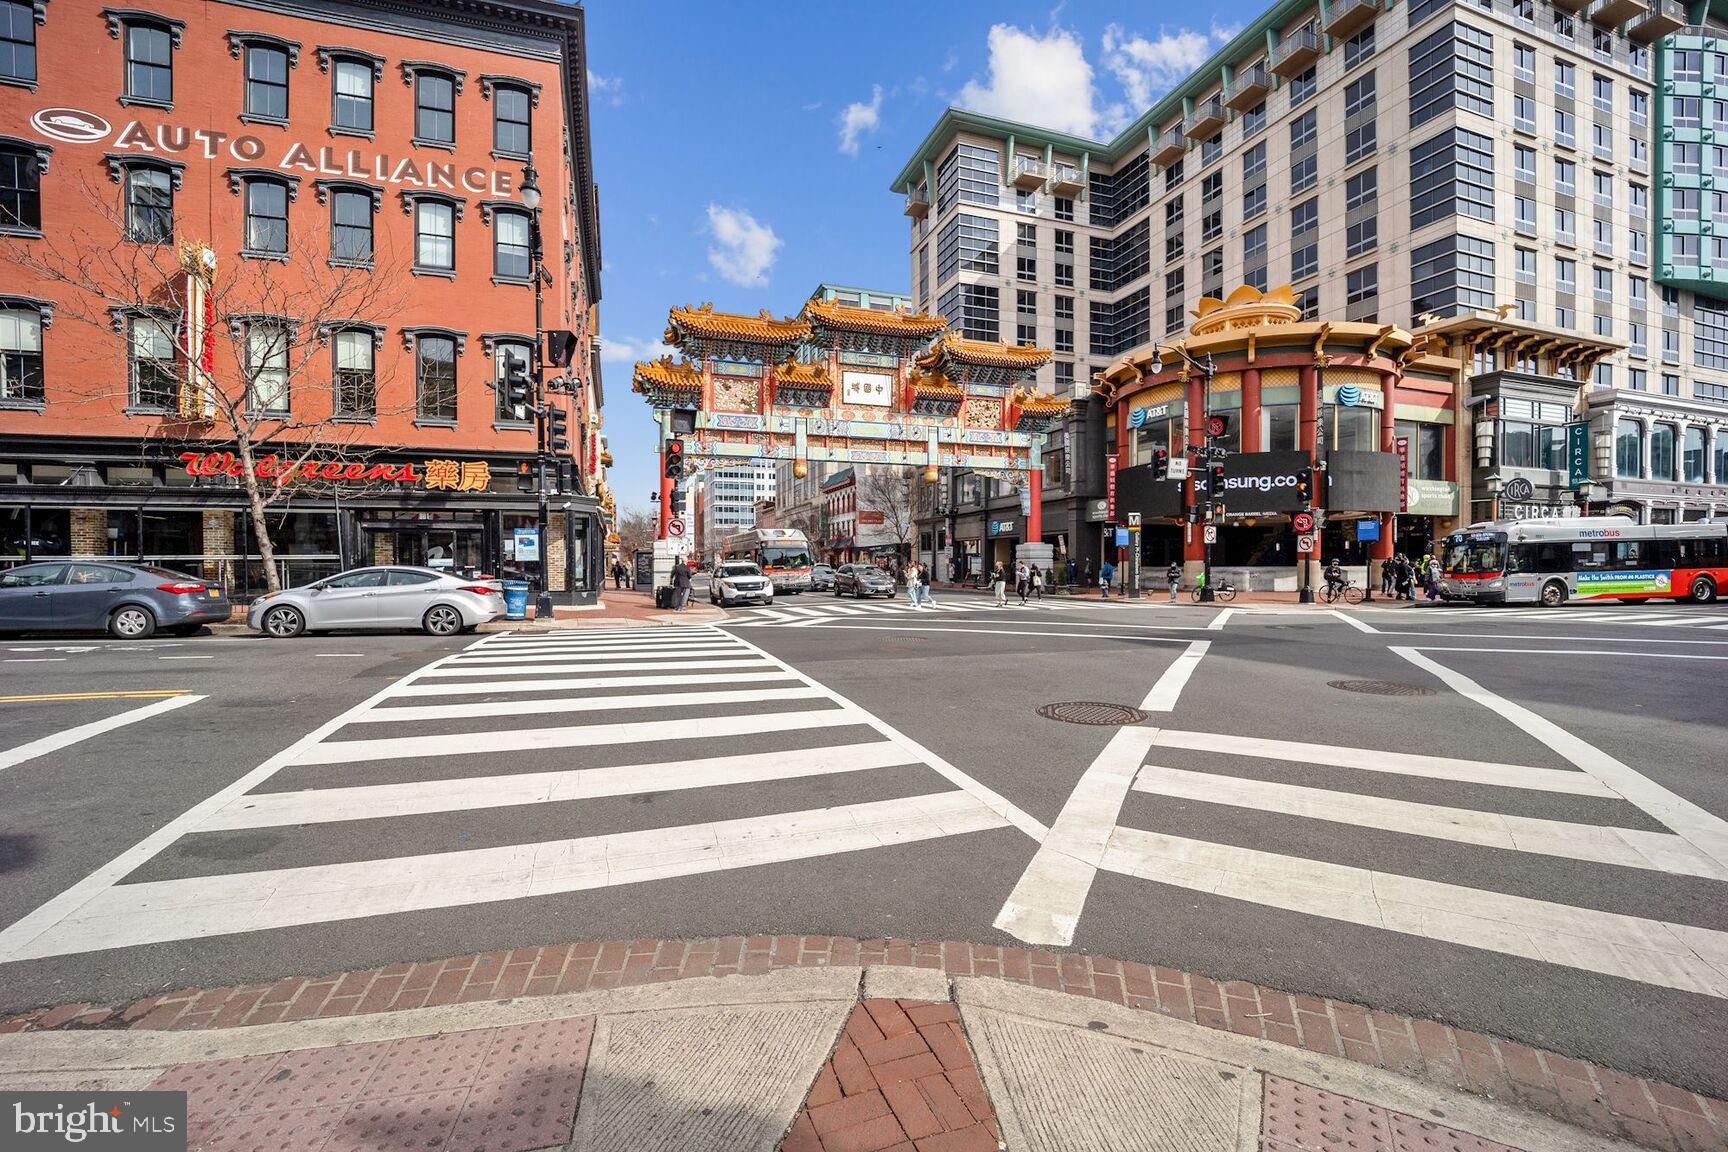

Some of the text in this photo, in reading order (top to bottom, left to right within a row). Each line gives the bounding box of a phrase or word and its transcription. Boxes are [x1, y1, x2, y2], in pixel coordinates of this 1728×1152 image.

[113, 120, 513, 197] AUTO ALLIANCE
[1146, 405, 1168, 420] AT&T
[1574, 428, 1582, 476] CIRCA
[179, 452, 422, 486] Walgreens
[424, 459, 490, 492] 藥房
[1507, 479, 1530, 499] CIRCA
[1129, 515, 1140, 526] M
[1514, 505, 1559, 519] CIRCA
[999, 521, 1014, 532] AT&T
[1579, 528, 1620, 537] metrobus
